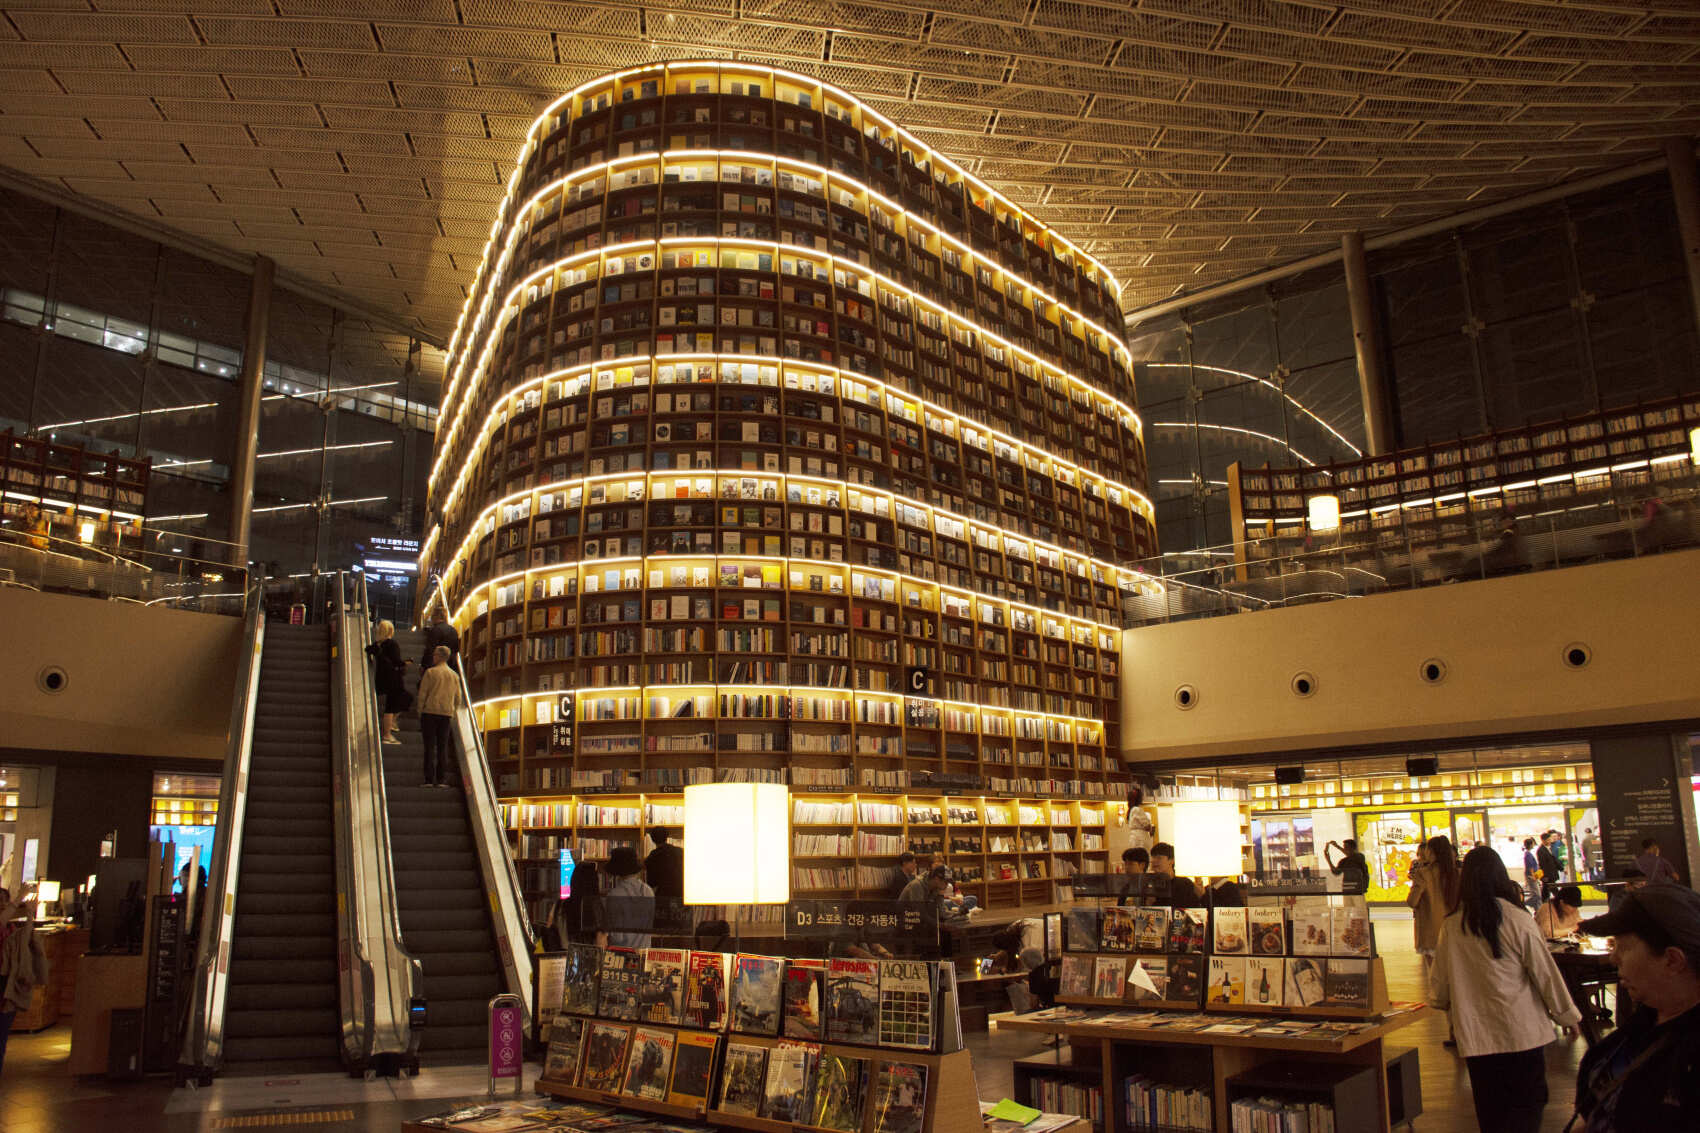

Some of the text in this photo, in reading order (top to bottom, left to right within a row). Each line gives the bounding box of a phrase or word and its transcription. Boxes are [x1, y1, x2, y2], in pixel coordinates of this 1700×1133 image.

[913, 671, 924, 690] C
[561, 696, 571, 716] C
[797, 911, 897, 927] D3 스포츠 건강 자동차
[882, 962, 919, 980] AQUA
